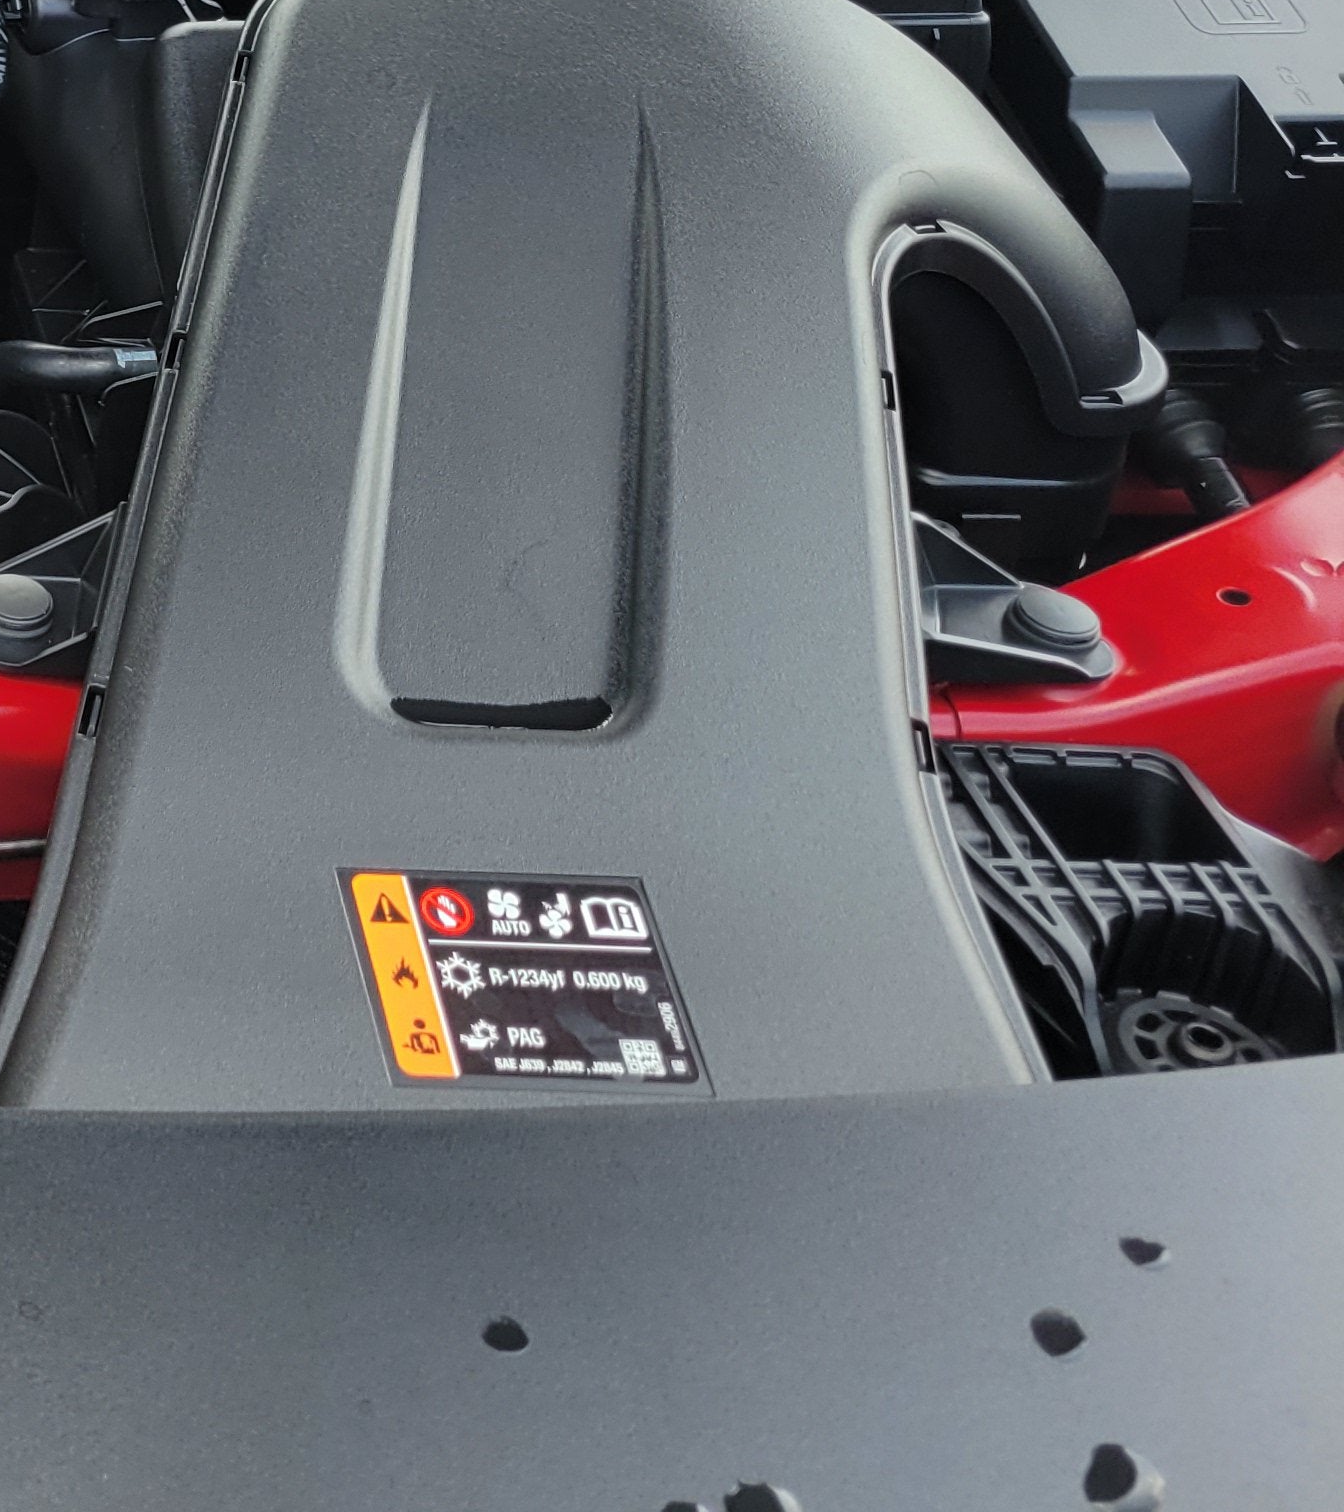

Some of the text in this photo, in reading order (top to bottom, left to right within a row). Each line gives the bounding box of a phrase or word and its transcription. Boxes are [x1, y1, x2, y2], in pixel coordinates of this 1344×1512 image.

[492, 919, 531, 937] AUTO
[488, 967, 648, 994] R-1234yf 0.600 kg
[507, 1026, 546, 1048] PAG
[494, 1056, 517, 1071] SAE
